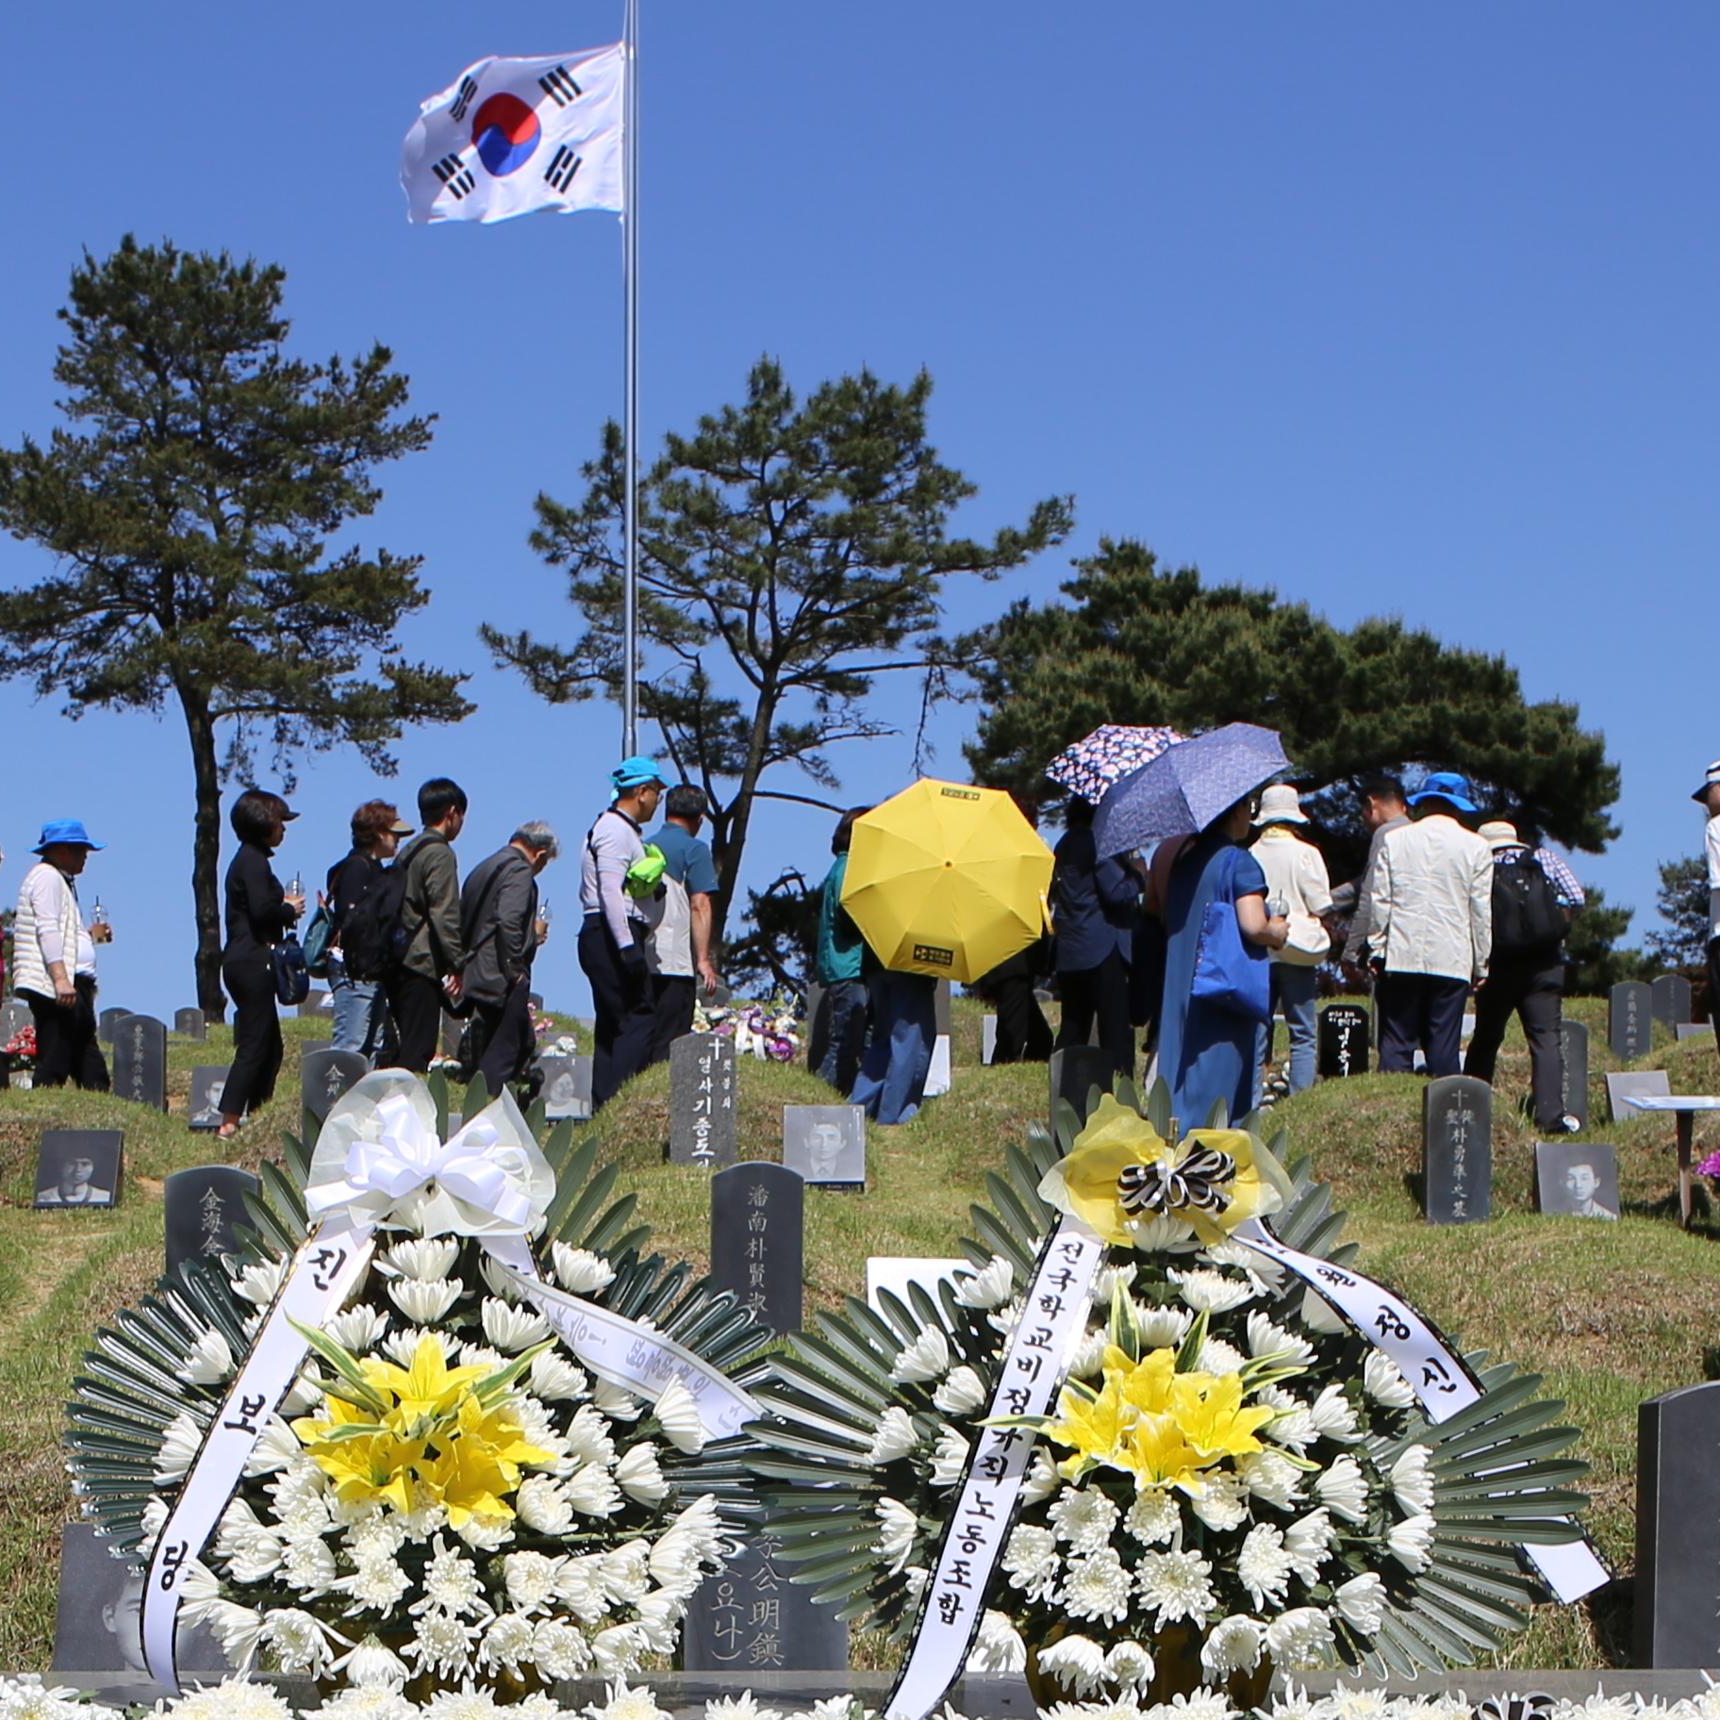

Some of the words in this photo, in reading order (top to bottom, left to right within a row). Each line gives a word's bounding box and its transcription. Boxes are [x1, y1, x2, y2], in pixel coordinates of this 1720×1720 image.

[743, 1184, 771, 1313] 潘南朴賢淑
